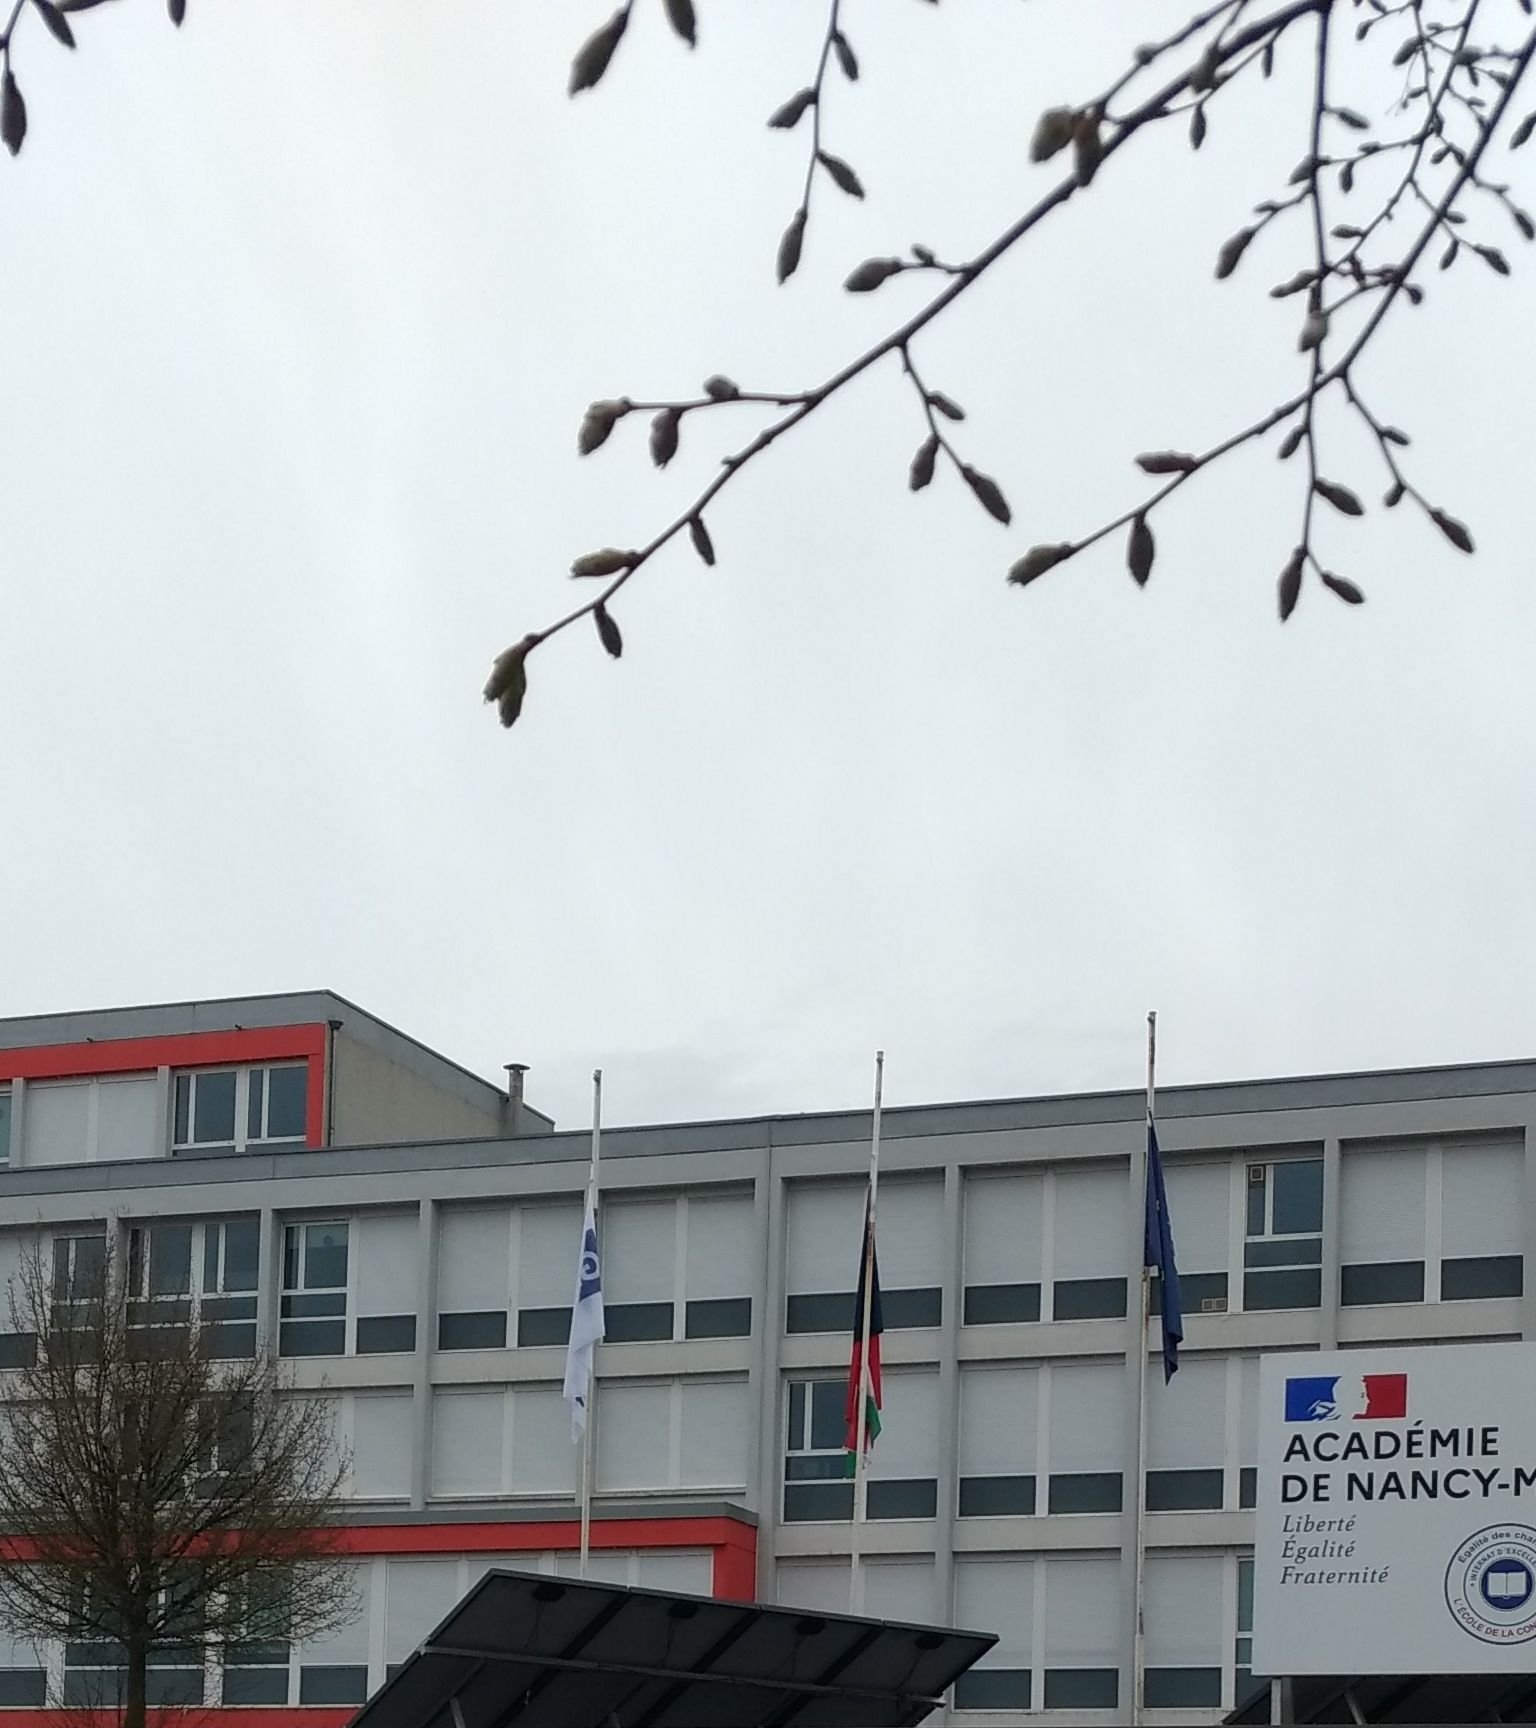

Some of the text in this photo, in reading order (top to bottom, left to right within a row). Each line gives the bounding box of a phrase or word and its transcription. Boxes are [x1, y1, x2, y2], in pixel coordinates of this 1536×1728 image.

[1282, 1419, 1500, 1463] ACADÉMIE
[1280, 1473, 1331, 1504] DE
[1282, 1513, 1358, 1534] Liberté
[1491, 1531, 1511, 1540] des
[1280, 1534, 1356, 1564] Égalité
[1279, 1564, 1391, 1586] Fraternité
[1484, 1627, 1499, 1637] DE
[1501, 1629, 1515, 1638] LA
